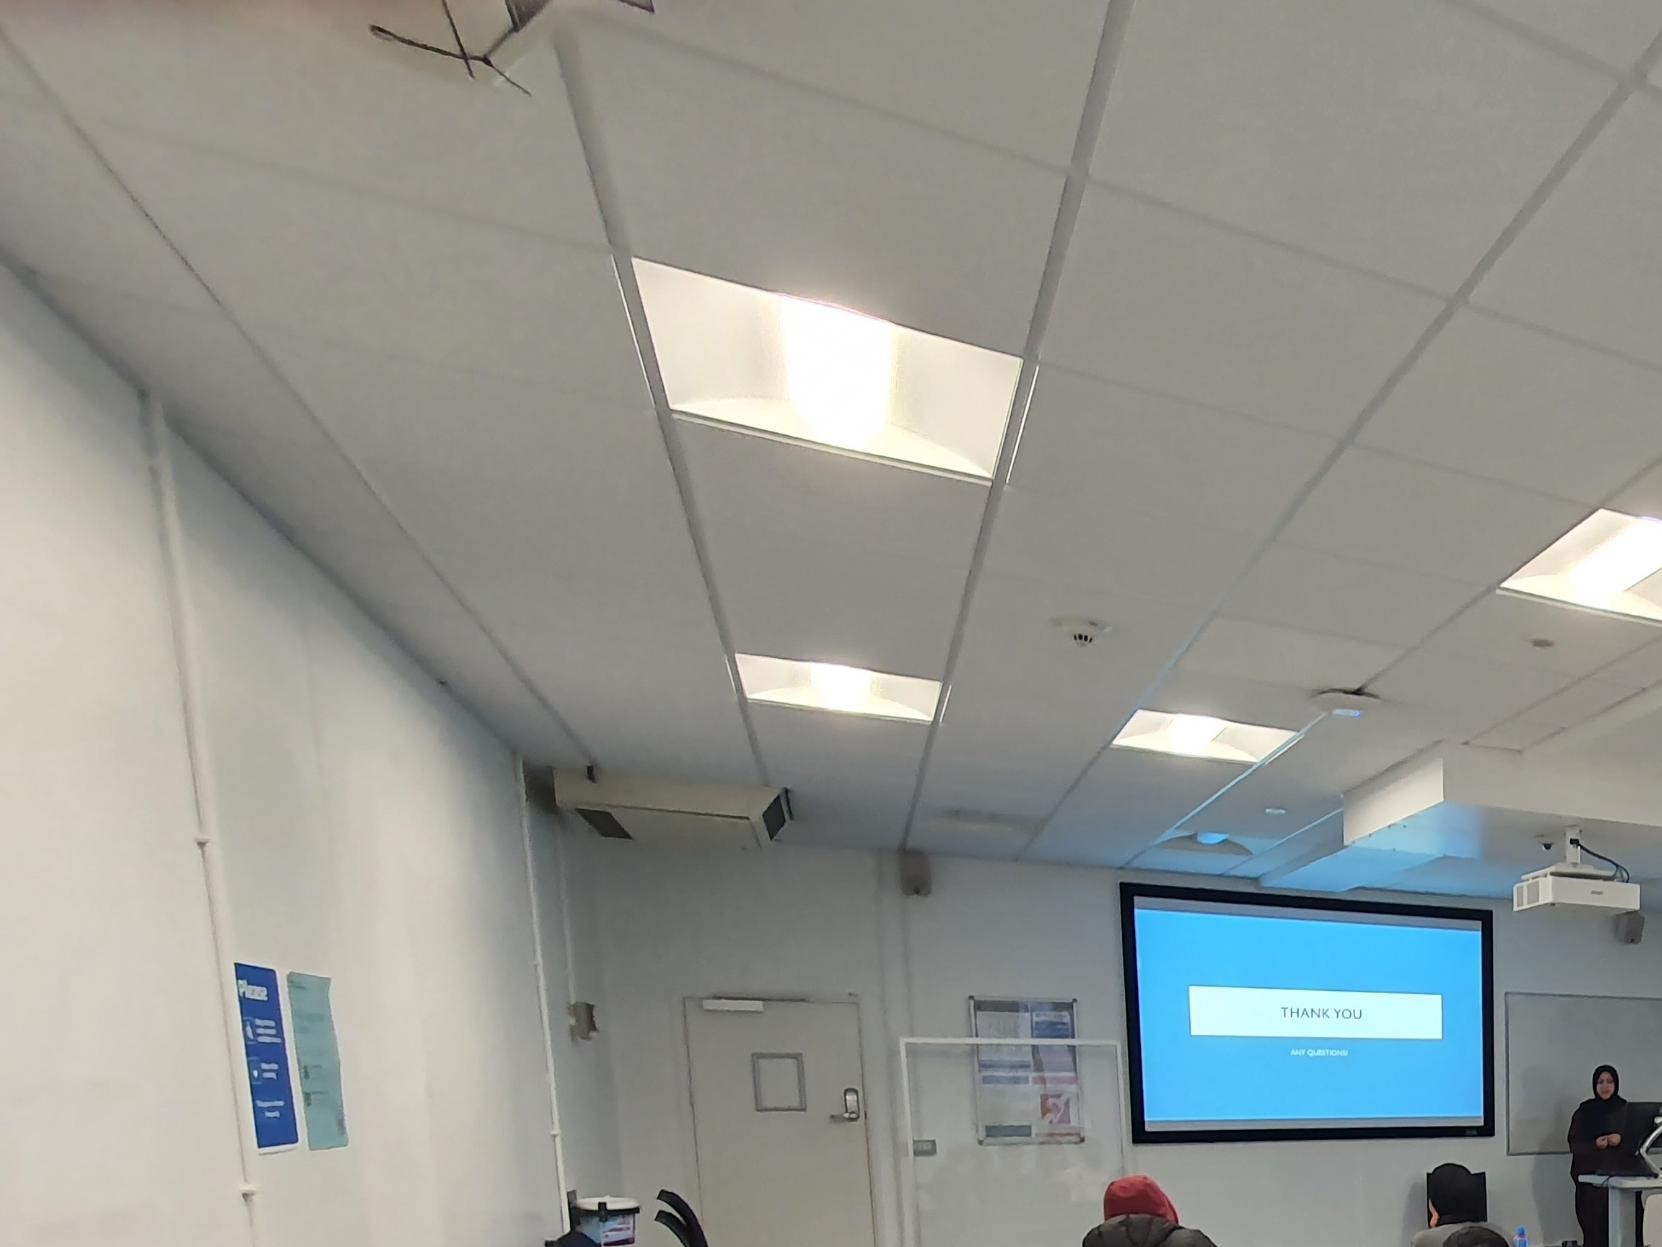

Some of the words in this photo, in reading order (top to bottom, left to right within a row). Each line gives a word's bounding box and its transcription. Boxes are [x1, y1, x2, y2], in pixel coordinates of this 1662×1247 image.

[1280, 1006, 1330, 1019] THANK
[1334, 1008, 1363, 1020] YOU
[1290, 1048, 1306, 1057] ANY
